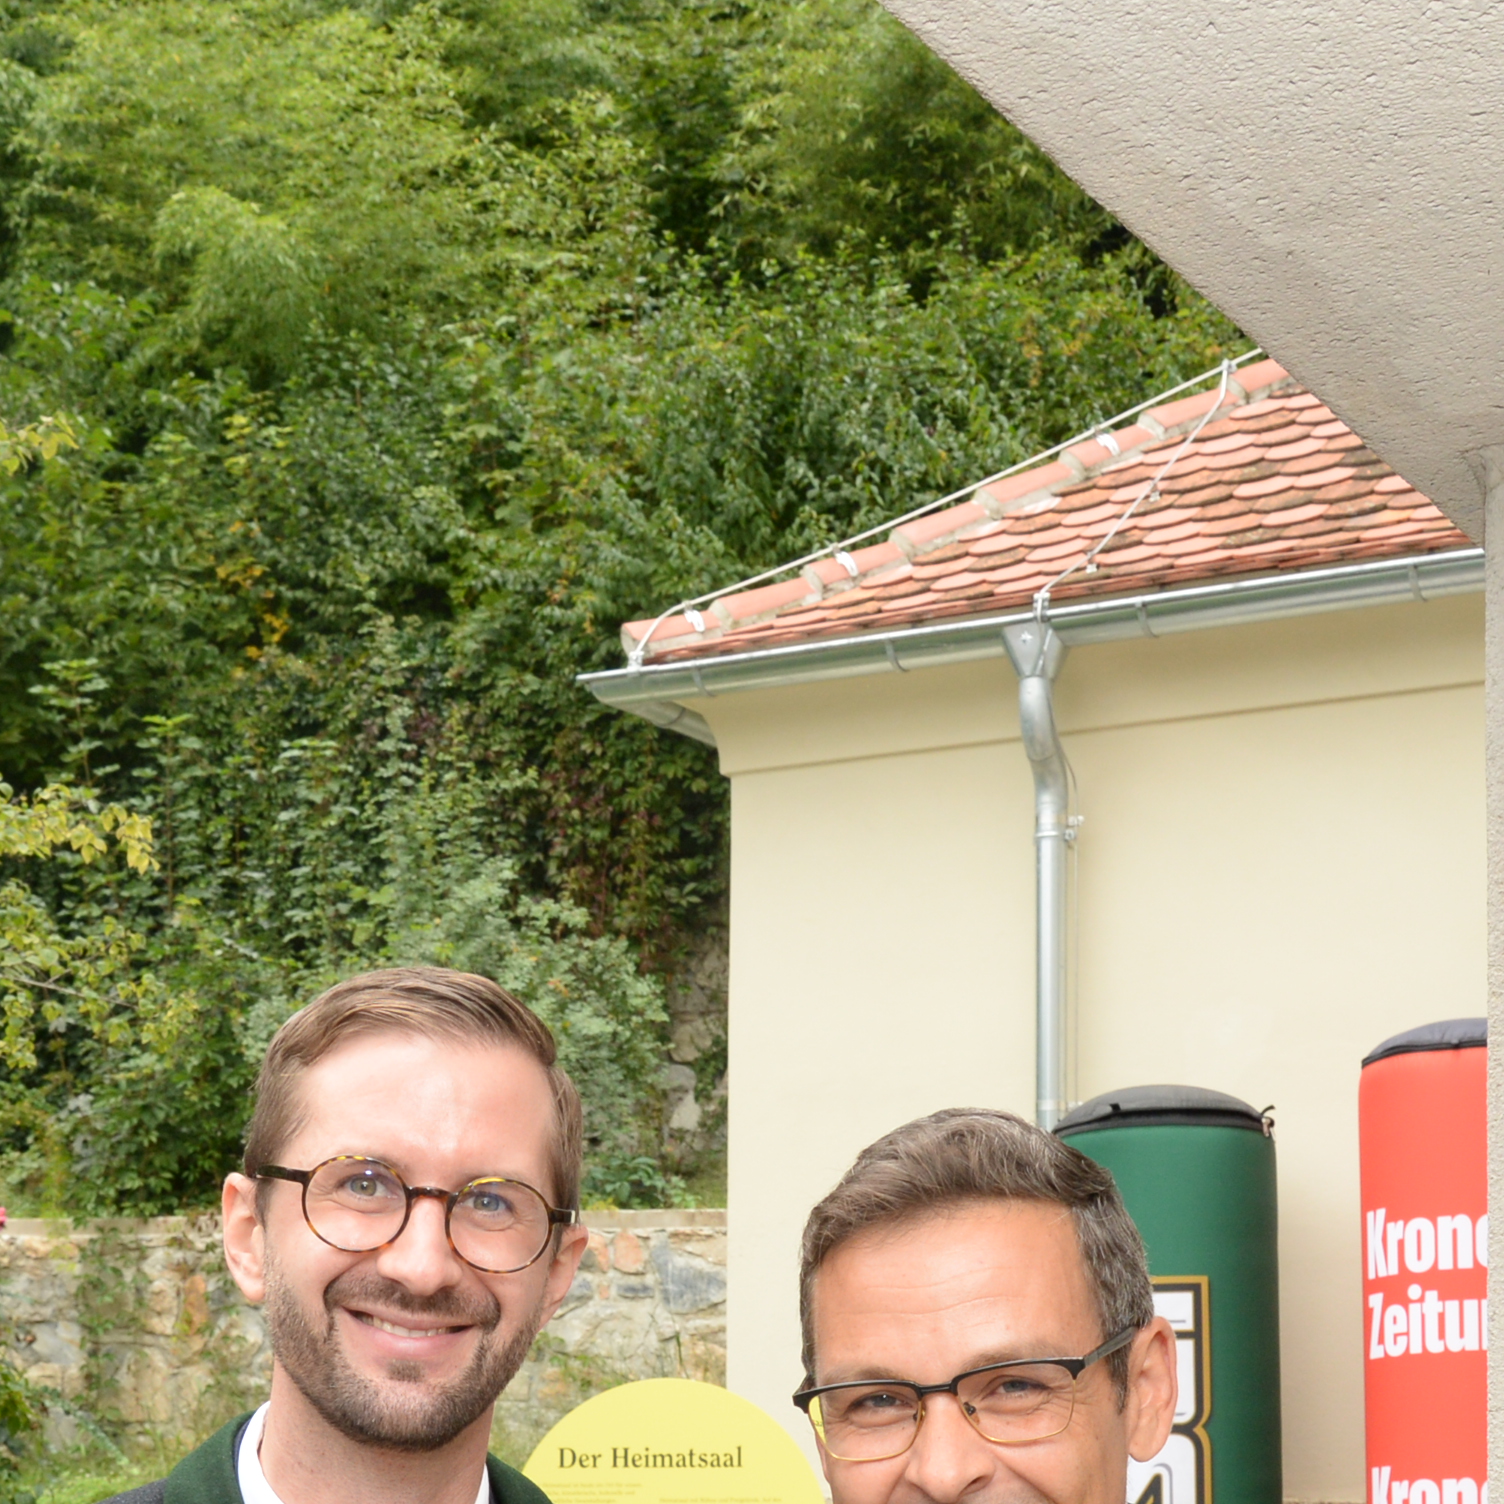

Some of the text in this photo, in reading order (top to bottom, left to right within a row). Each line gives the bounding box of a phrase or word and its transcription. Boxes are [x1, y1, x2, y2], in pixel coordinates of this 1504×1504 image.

[1368, 1283, 1488, 1360] Zeitu
[558, 1445, 743, 1469] Der Heimatsaal
